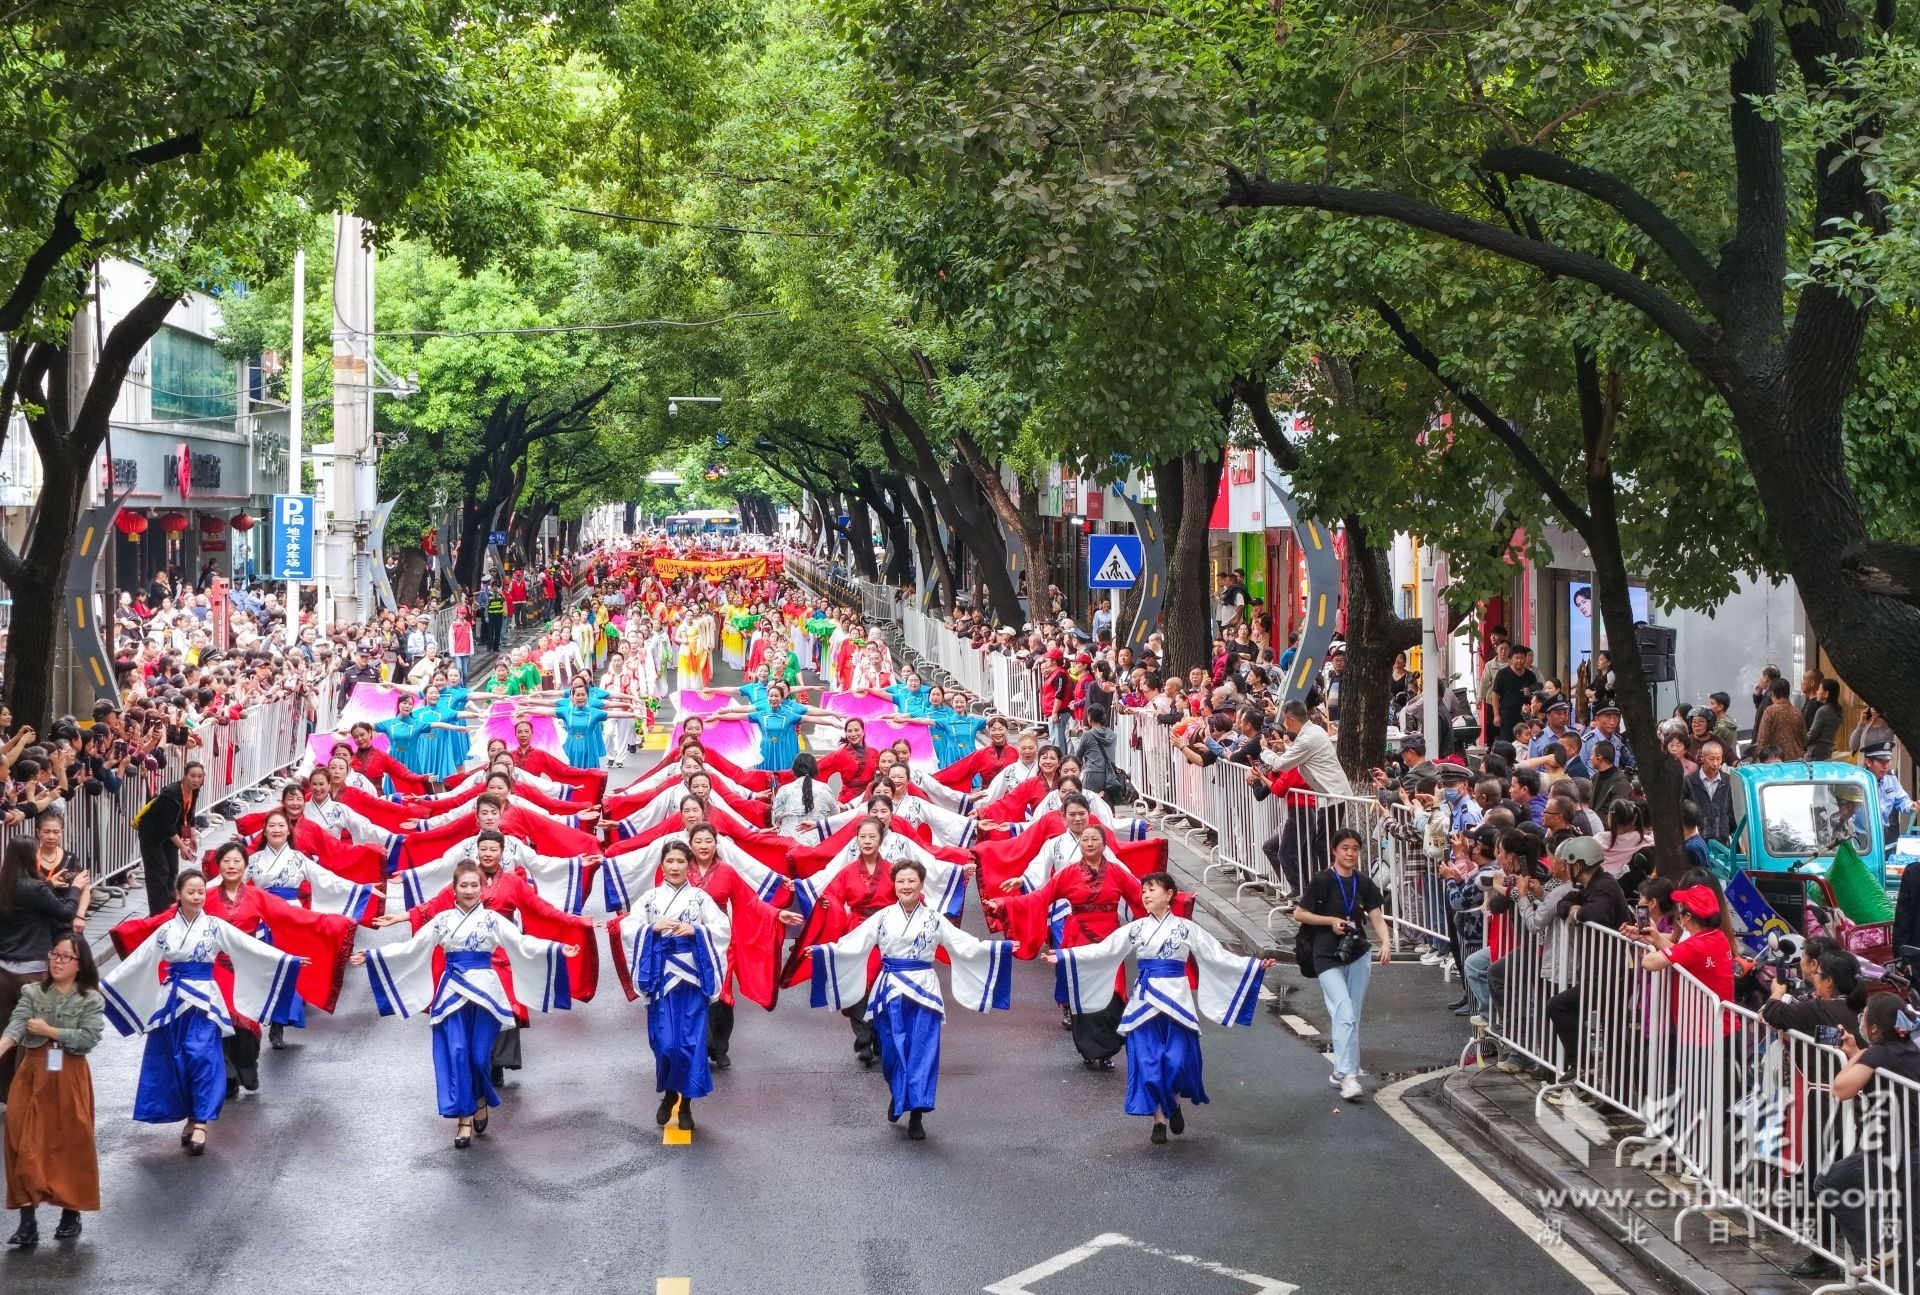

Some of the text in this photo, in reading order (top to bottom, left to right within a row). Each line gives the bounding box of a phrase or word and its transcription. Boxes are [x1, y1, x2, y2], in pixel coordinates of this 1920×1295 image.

[283, 498, 303, 525] P
[286, 527, 300, 567] 地下停车场
